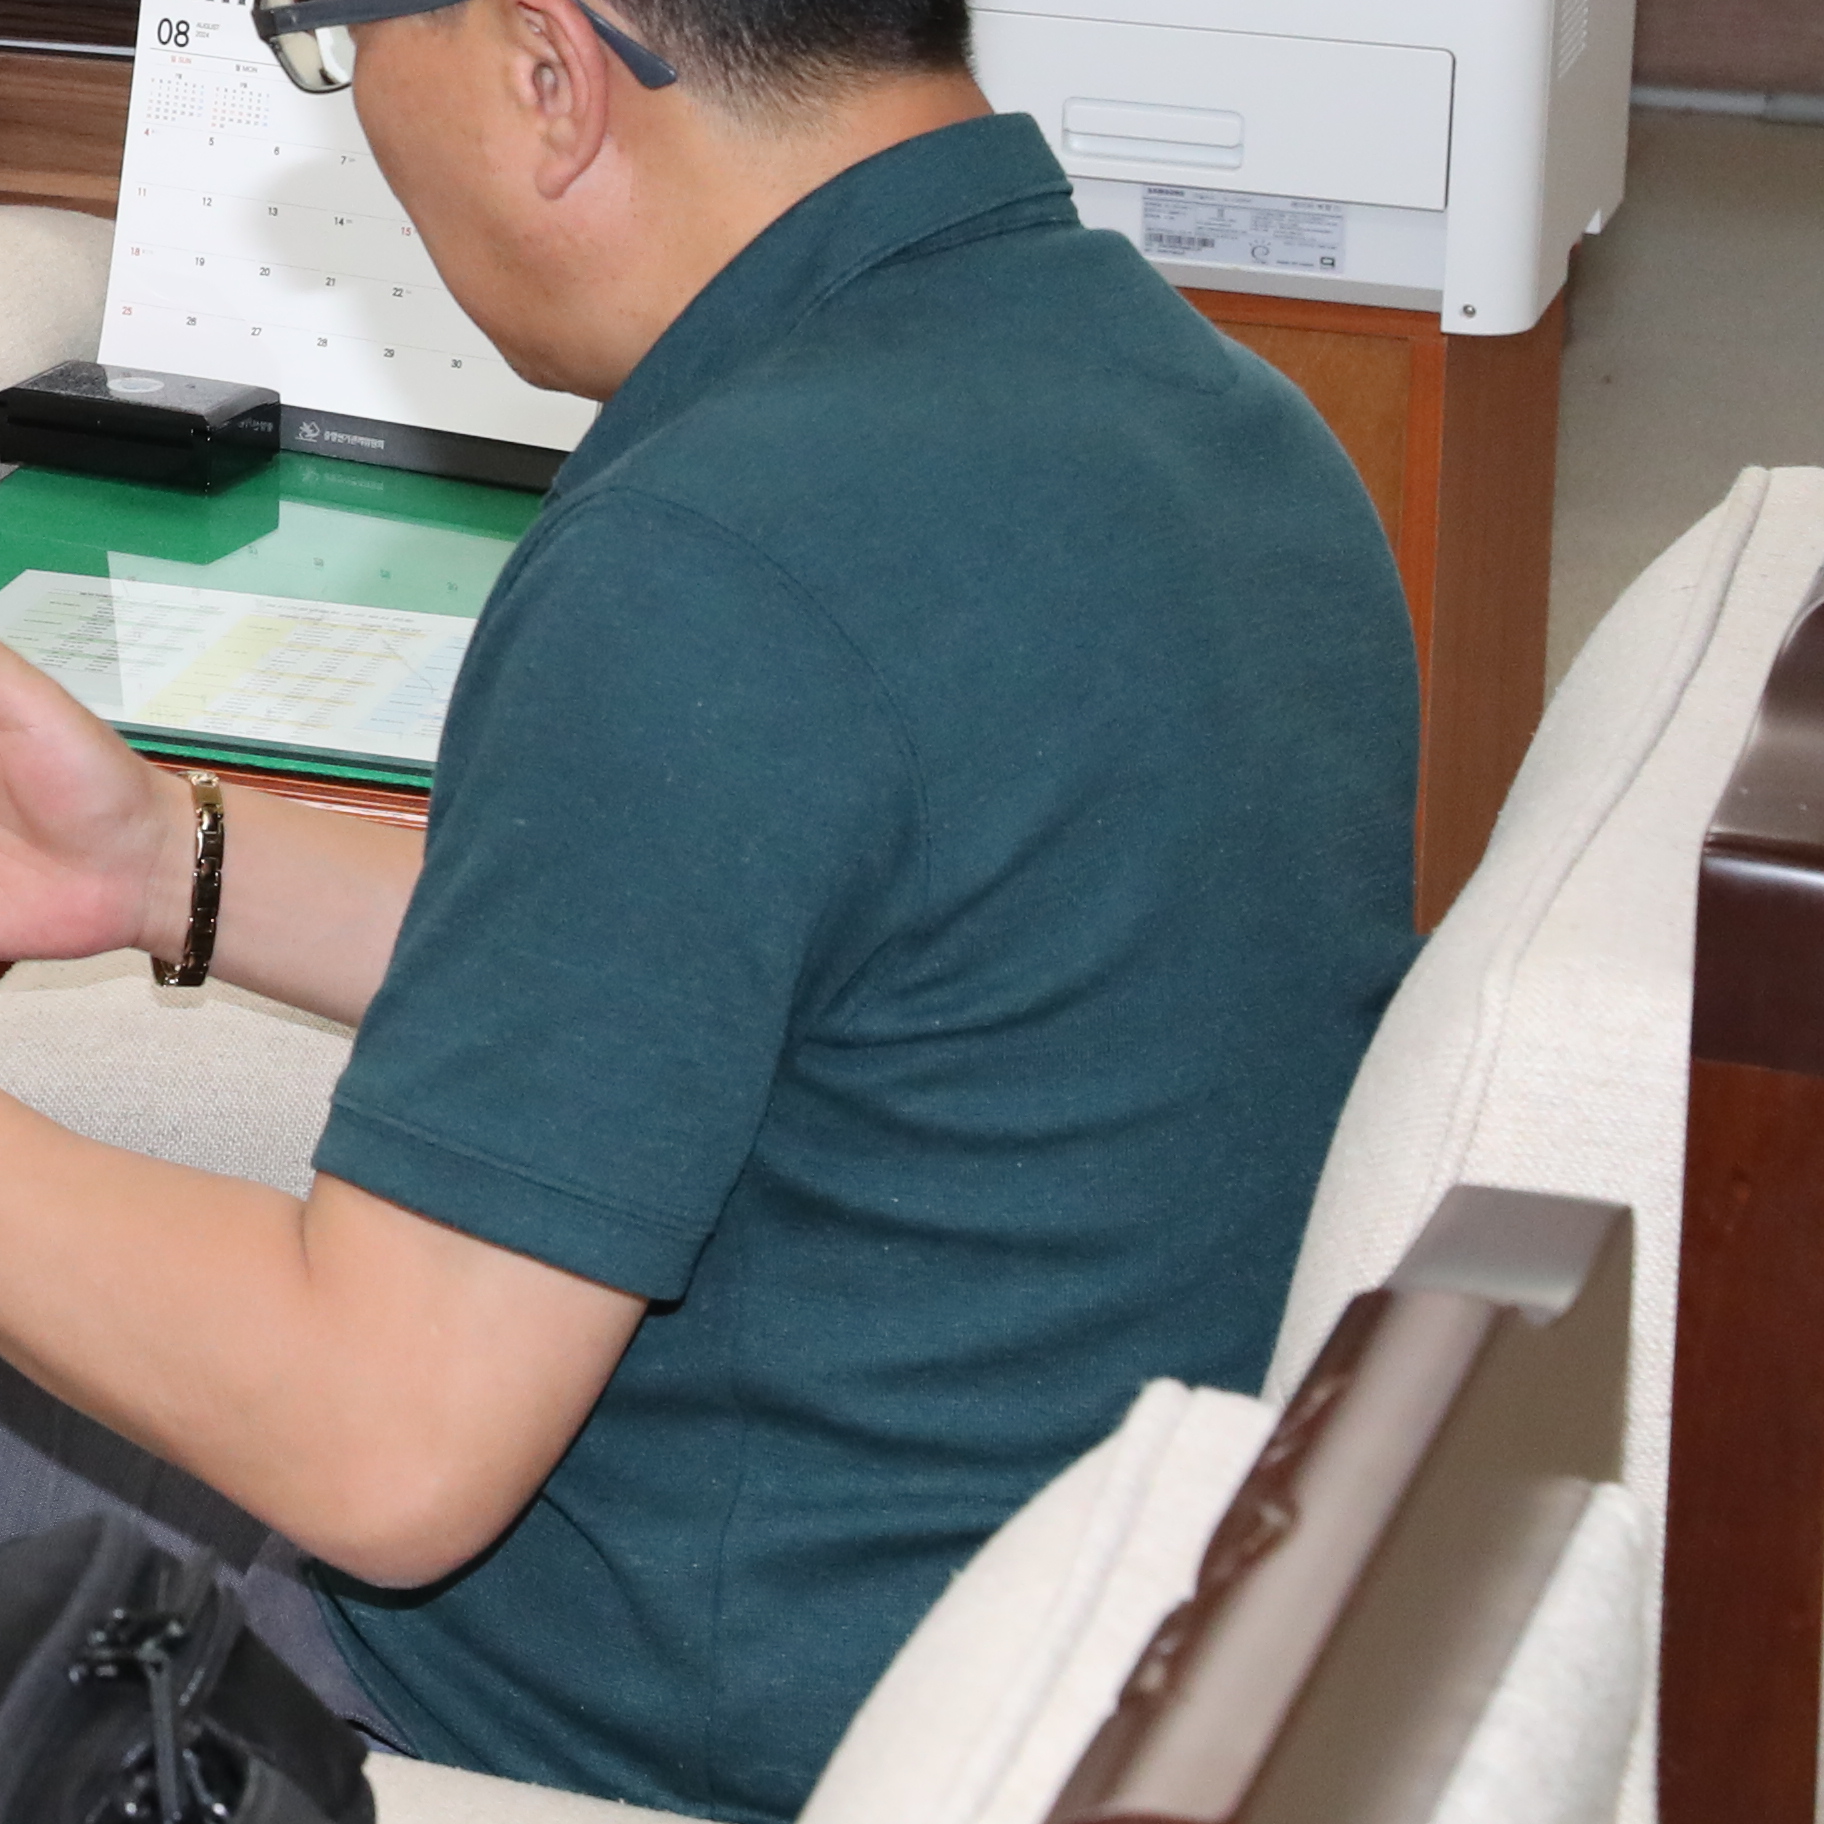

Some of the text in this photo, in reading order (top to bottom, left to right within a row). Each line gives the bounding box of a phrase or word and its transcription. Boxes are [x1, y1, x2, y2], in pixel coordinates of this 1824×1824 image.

[157, 18, 190, 48] 08
[210, 137, 215, 146] 5
[274, 147, 279, 155] 6
[341, 156, 347, 164] 7
[138, 187, 411, 236] 11 12 13 14 15
[131, 247, 403, 297] 18 19 20 21 22
[122, 306, 462, 368] 25 26 27 28 29 30
